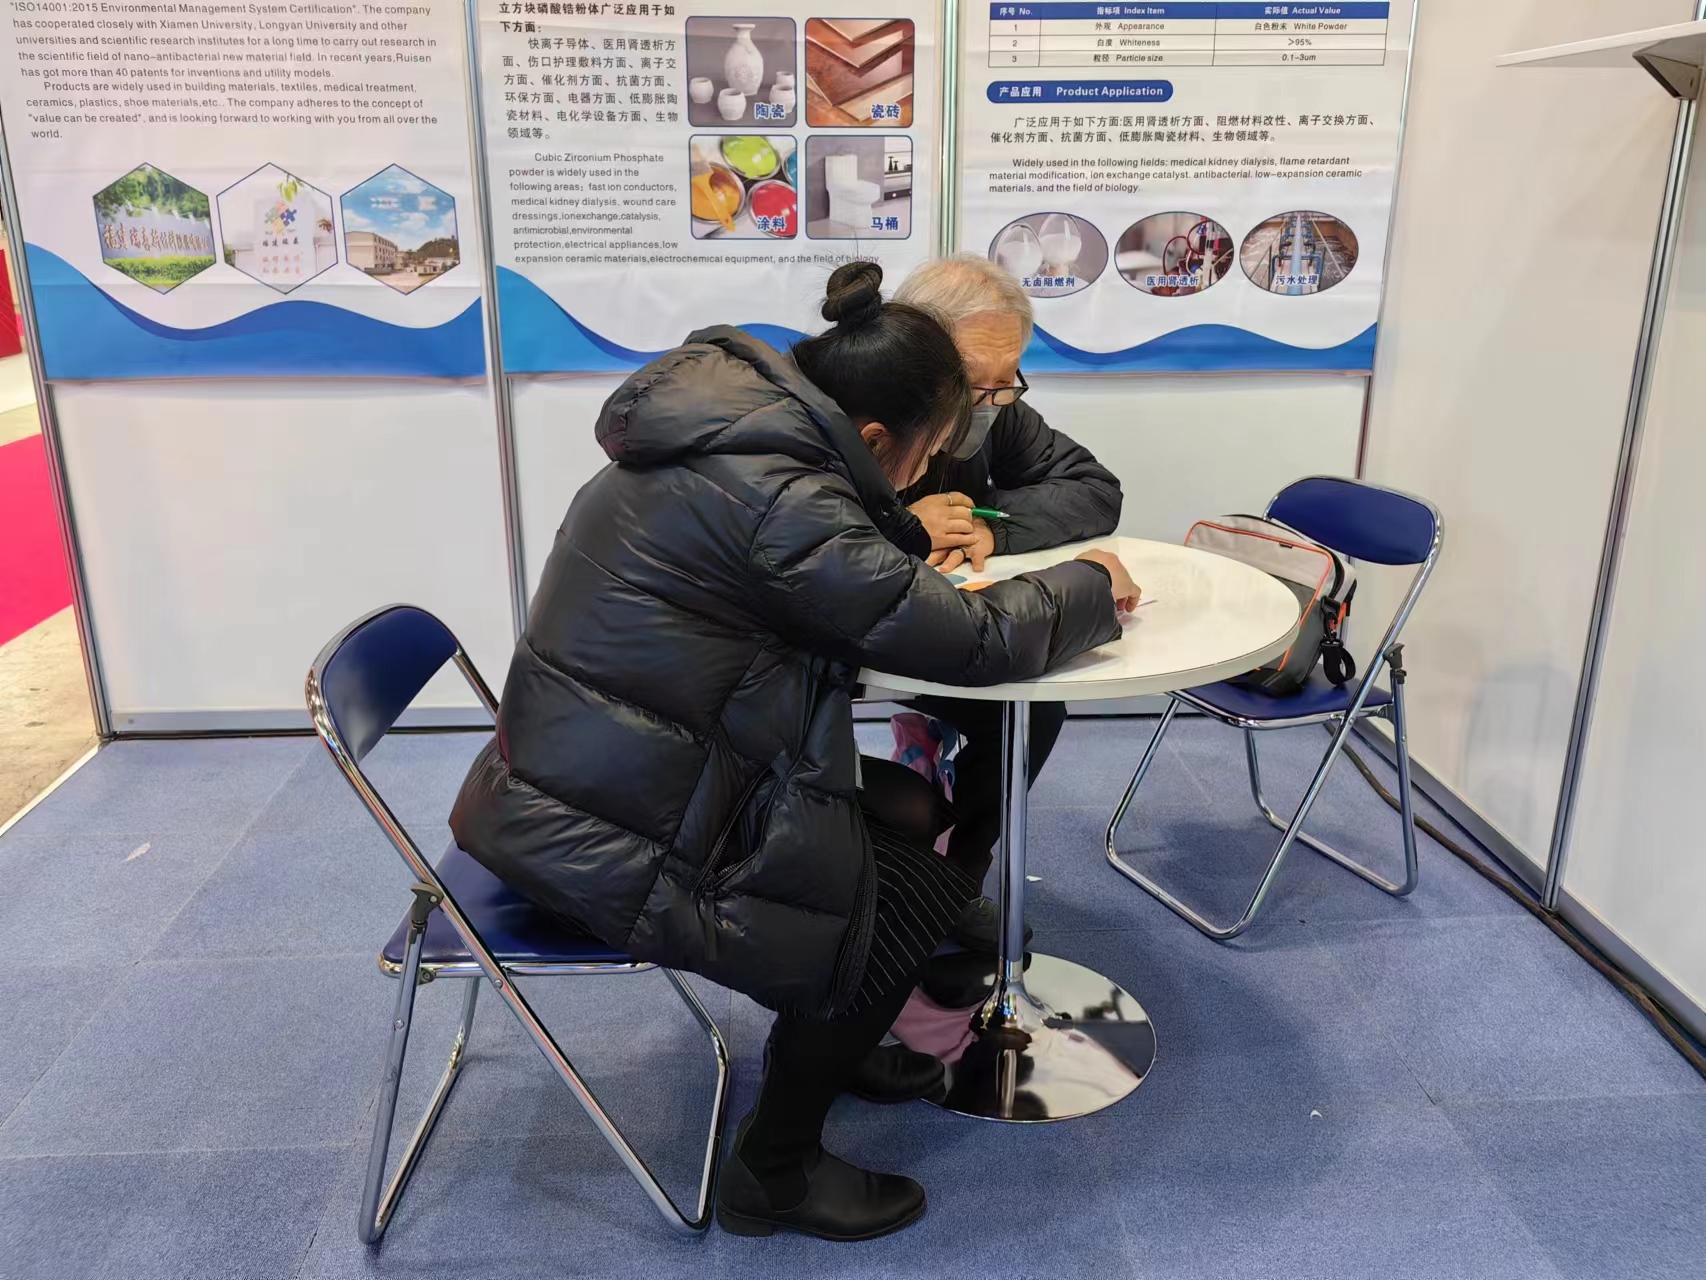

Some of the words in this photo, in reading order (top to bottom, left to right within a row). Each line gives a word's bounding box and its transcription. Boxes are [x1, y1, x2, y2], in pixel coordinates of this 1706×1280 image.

[100, 2, 177, 13] Environmental
[178, 3, 246, 15] Management
[248, 3, 287, 15] System
[362, 4, 382, 14] The
[384, 6, 431, 16] company
[999, 7, 1015, 16] 序号
[1097, 6, 1120, 15] 指标项
[1264, 6, 1288, 15] 实际值
[12, 18, 33, 28] has
[34, 20, 95, 30] cooperated
[96, 19, 134, 31] closely
[136, 20, 157, 29] with
[159, 19, 199, 29] Xiamen
[259, 20, 303, 32] Longyan
[305, 20, 357, 32] University
[359, 21, 379, 30] and
[381, 21, 407, 30] other
[1095, 22, 1111, 31] 外观
[1117, 22, 1165, 31] Appearance
[1254, 22, 1288, 31] 白色粉末
[1097, 38, 1113, 47] 白度
[18, 52, 35, 61] the
[37, 51, 85, 61] scientific
[86, 51, 109, 61] field
[111, 52, 121, 61] of
[246, 52, 287, 62] material
[317, 52, 327, 61] In
[330, 53, 362, 62] recent
[1093, 54, 1110, 62] 粒径
[1116, 54, 1146, 62] Particle
[1147, 54, 1163, 62] size
[20, 68, 41, 77] has
[42, 68, 59, 79] got
[61, 69, 88, 77] more
[90, 68, 113, 77] than
[115, 68, 128, 77] 40
[130, 68, 169, 78] patents
[170, 68, 185, 77] for
[187, 68, 241, 77] inventions
[243, 68, 262, 77] and
[264, 68, 291, 79] utility
[43, 81, 90, 91] Products
[93, 83, 109, 91] are
[111, 82, 144, 93] widely
[146, 82, 171, 91] used
[173, 82, 183, 91] in
[184, 82, 226, 93] building
[323, 82, 364, 92] medical
[999, 86, 1042, 97] 产品应用
[1056, 86, 1099, 96] Product
[1101, 86, 1163, 97] Application
[755, 103, 785, 119] 陶瓷
[871, 104, 901, 120] 瓷砖
[534, 152, 562, 162] Cubic
[564, 153, 611, 162] Zirconium
[613, 153, 664, 164] Phosphate
[1012, 158, 1044, 168] Widely
[1046, 158, 1069, 167] used
[1070, 158, 1079, 167] in
[1081, 158, 1096, 167] the
[1097, 158, 1139, 168] following
[1170, 158, 1207, 166] medical
[1208, 157, 1239, 167] kidney
[1280, 157, 1306, 165] flame
[1307, 156, 1350, 165] retardant
[509, 168, 545, 178] powder
[546, 168, 555, 177] is
[556, 168, 587, 178] widely
[589, 168, 612, 177] used
[614, 168, 623, 176] in
[624, 168, 639, 177] the
[989, 172, 1027, 180] material
[1090, 171, 1104, 179] ion
[1106, 171, 1151, 180] exchange
[1325, 169, 1362, 178] ceramic
[509, 182, 552, 193] following
[588, 182, 606, 191] fast
[1036, 184, 1054, 192] and
[1056, 184, 1071, 192] the
[1073, 183, 1093, 192] field
[1094, 183, 1103, 192] of
[511, 197, 548, 206] medical
[549, 197, 580, 208] kidney
[622, 198, 654, 206] wound
[757, 216, 787, 232] 涂料
[870, 216, 899, 231] 马桶
[515, 255, 563, 264] expansion
[565, 255, 602, 263] ceramic
[778, 255, 795, 264] and
[797, 254, 812, 263] the
[813, 254, 834, 264] field
[835, 255, 845, 263] of
[1275, 273, 1318, 286] 污水处理
